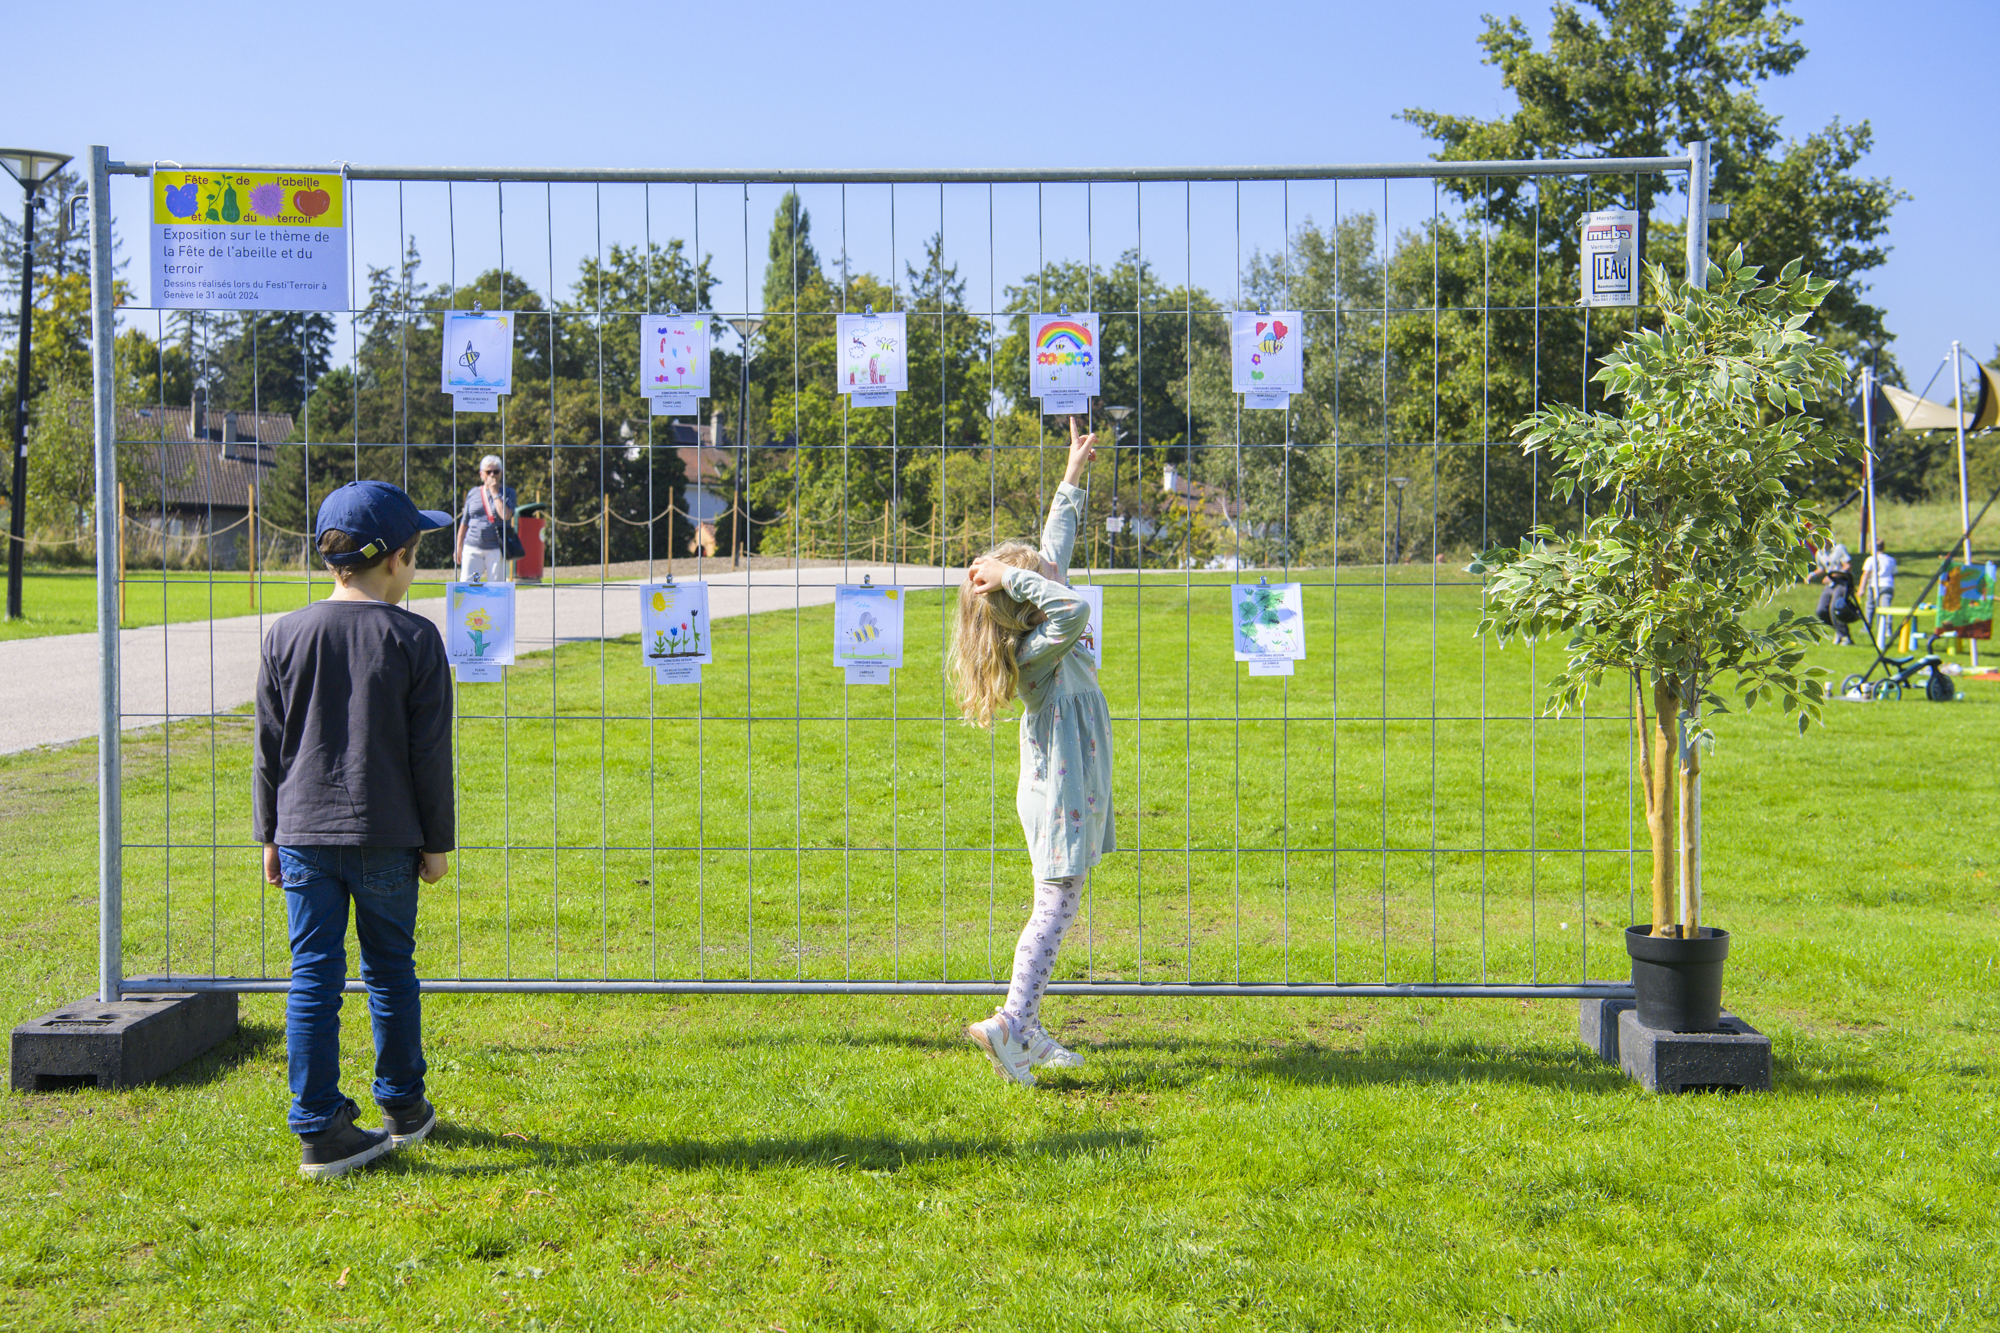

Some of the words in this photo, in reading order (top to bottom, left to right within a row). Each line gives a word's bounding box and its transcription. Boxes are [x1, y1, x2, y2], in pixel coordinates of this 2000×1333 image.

[185, 174, 209, 185] Fête
[236, 175, 250, 185] de
[277, 176, 320, 187] l'abeille
[191, 213, 202, 222] et
[243, 213, 257, 222] du
[277, 214, 313, 224] terroir
[163, 228, 226, 243] Exposition
[230, 232, 251, 241] sur
[255, 229, 266, 241] le
[270, 229, 310, 242] thème
[314, 231, 330, 242] de
[163, 245, 175, 257] la
[178, 245, 205, 257] Fête
[208, 246, 223, 257] de
[227, 246, 277, 258] l'abeille
[281, 248, 293, 259] et
[297, 247, 312, 259] du
[164, 262, 204, 274] terroir
[1597, 257, 1627, 280] LEAG
[164, 279, 196, 288] Dessins
[198, 279, 232, 288] réalisés
[233, 280, 250, 288] lors
[252, 280, 263, 288] du
[322, 281, 327, 290] à
[163, 290, 194, 299] Genève
[196, 291, 204, 299] le
[205, 291, 215, 299] 31
[217, 291, 236, 299] août
[239, 291, 259, 299] 2024
